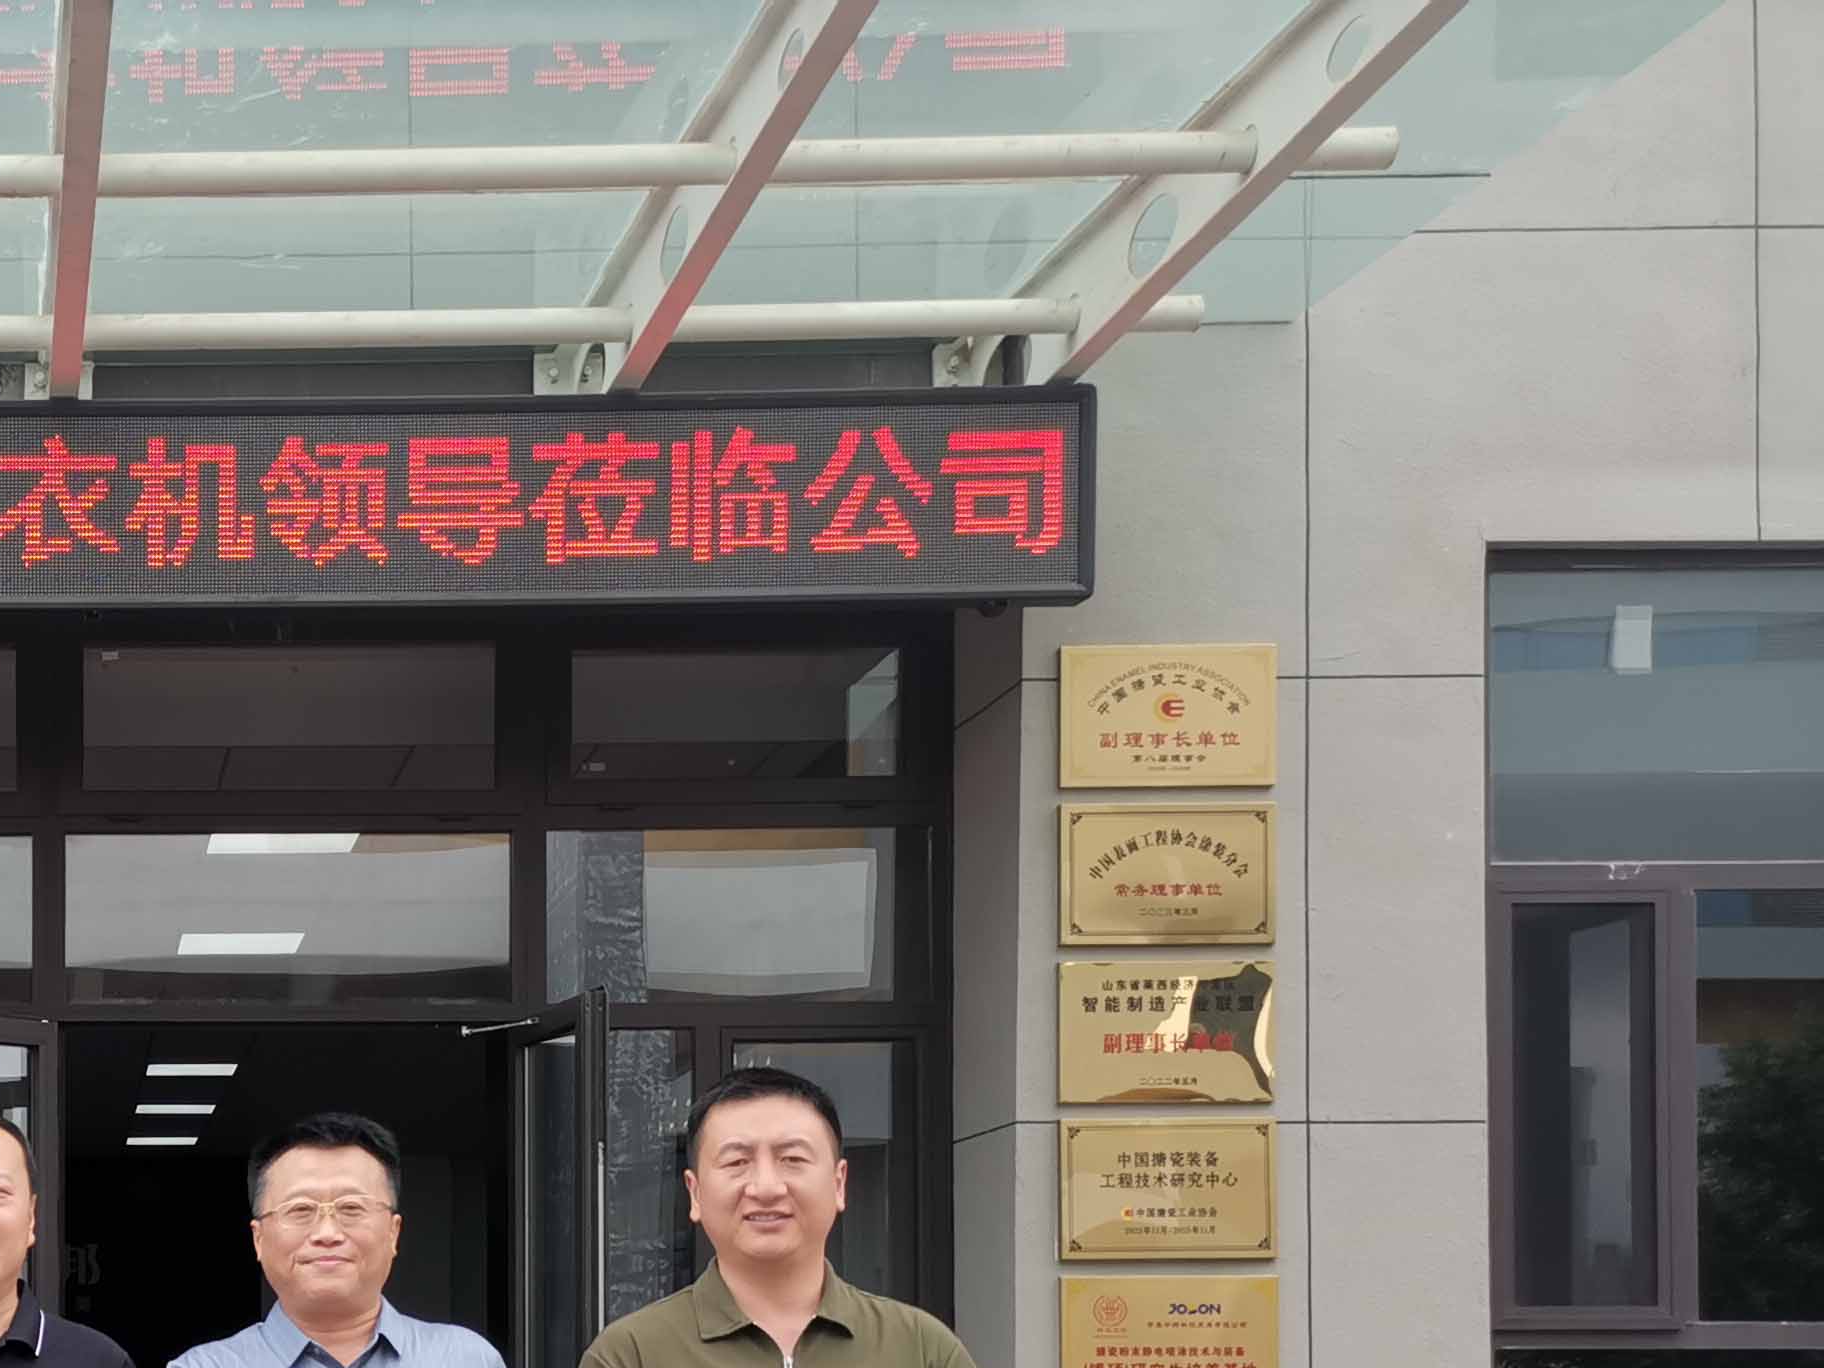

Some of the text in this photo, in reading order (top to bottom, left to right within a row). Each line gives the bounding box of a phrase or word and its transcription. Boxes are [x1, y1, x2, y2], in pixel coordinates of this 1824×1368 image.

[1099, 731, 1241, 749] 副理事长单位
[1113, 882, 1224, 897] 常务理事单位
[1081, 995, 1255, 1013] 智能制造产业联盟
[1117, 1151, 1220, 1168] 中国搪瓷装备
[1099, 1172, 1239, 1190] 工程技术研究中心
